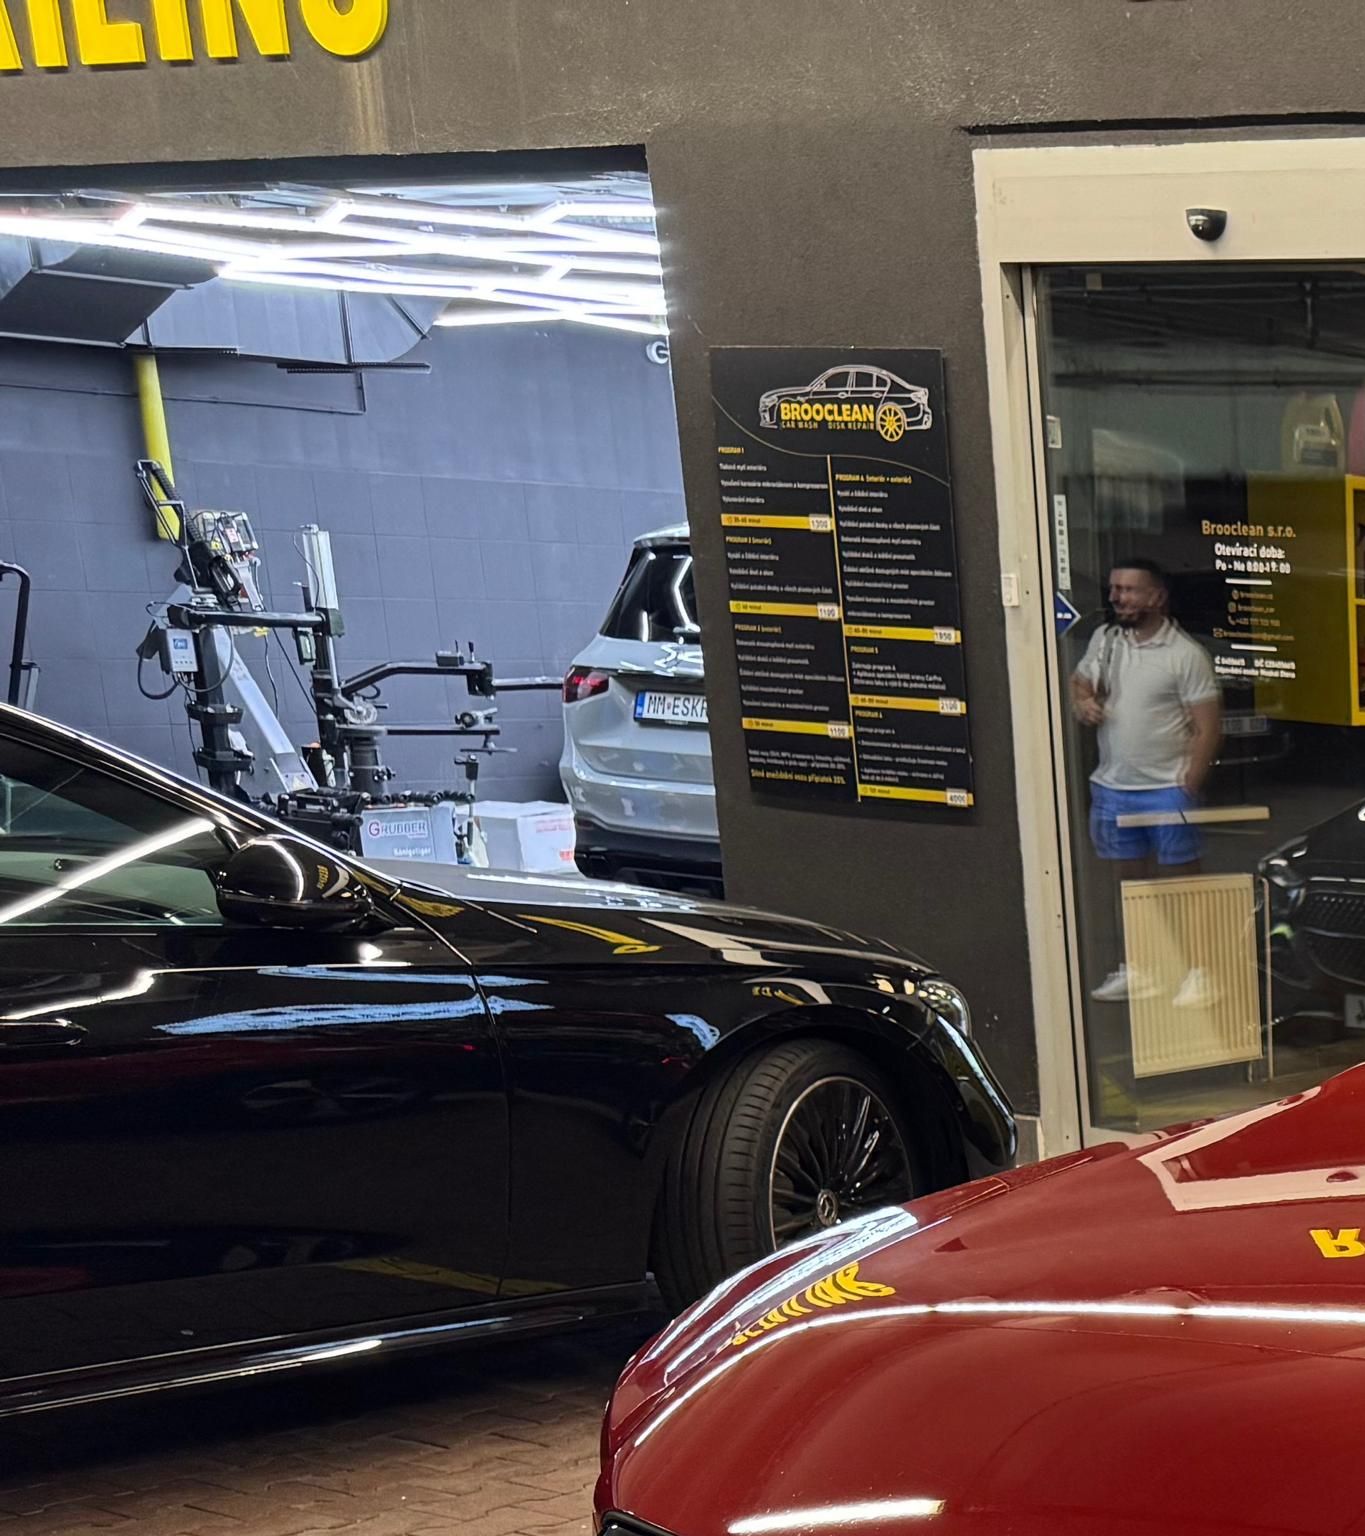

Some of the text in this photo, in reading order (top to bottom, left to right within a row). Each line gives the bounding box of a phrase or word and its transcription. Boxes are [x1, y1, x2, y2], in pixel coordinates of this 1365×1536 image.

[780, 403, 874, 421] BROOCLEAN
[781, 421, 796, 429] CAR
[798, 421, 818, 429] WASH
[848, 422, 874, 430] REPAIR
[1202, 520, 1297, 538] Brooclean s.r.o.
[1259, 545, 1286, 559] doba:
[1215, 560, 1227, 571] Po
[1233, 560, 1245, 572] Ne
[647, 694, 666, 715] MM
